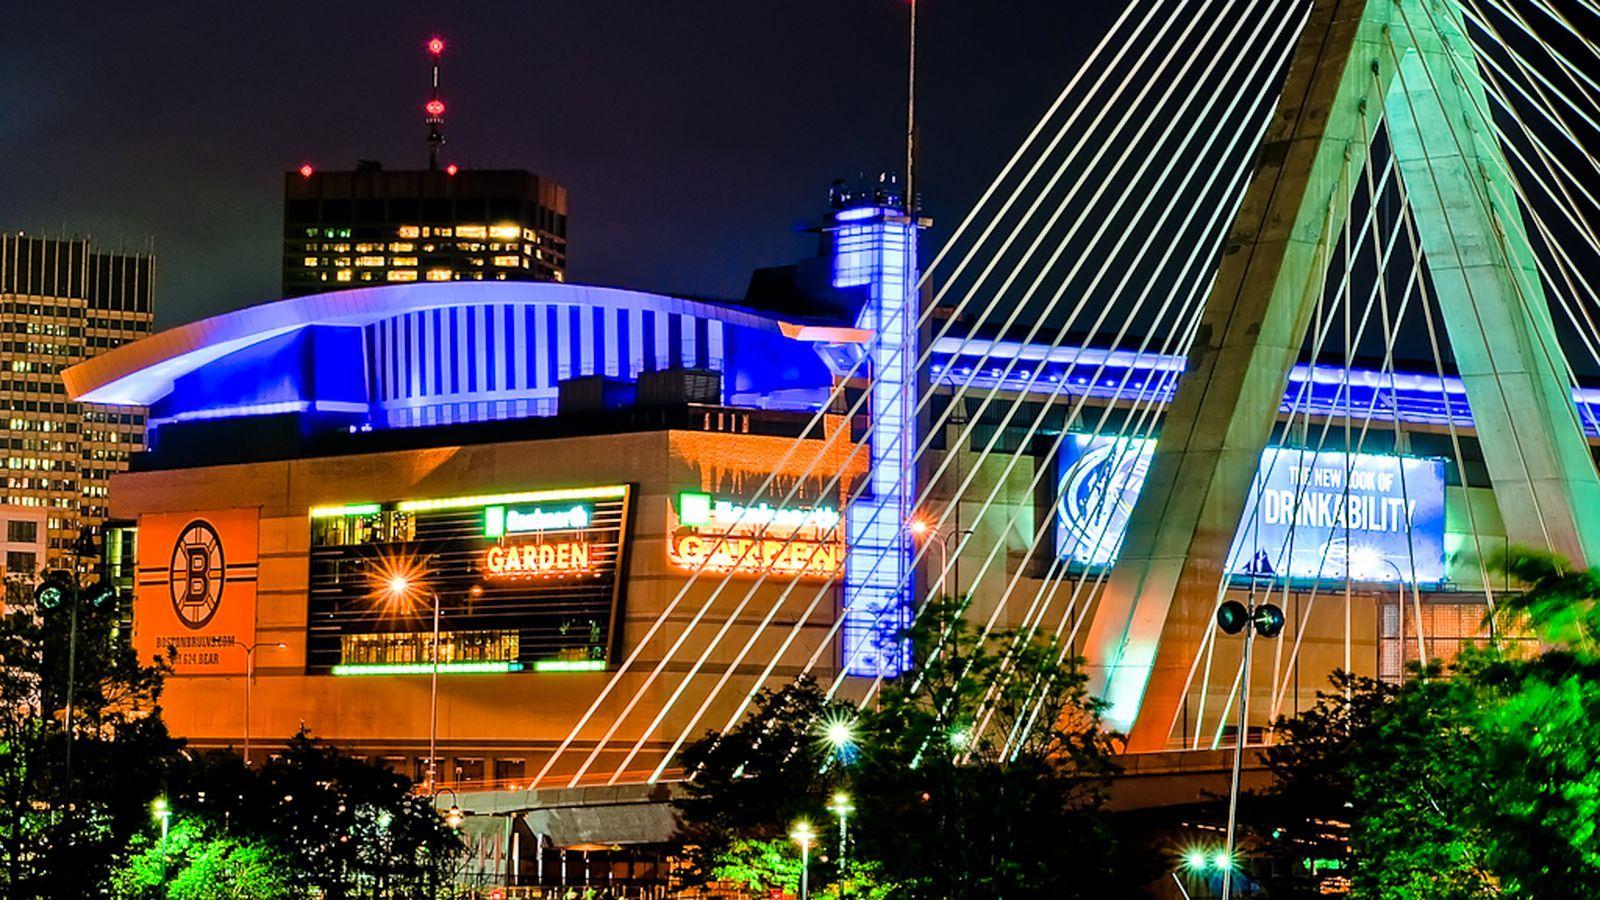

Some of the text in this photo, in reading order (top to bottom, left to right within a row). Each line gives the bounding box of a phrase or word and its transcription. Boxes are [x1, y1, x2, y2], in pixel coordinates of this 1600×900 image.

[1289, 466, 1312, 485] THE
[1315, 468, 1340, 488] NEW
[1378, 472, 1394, 491] OF
[1264, 489, 1415, 533] DRINKABILITY
[487, 542, 588, 572] GARDEN
[679, 535, 836, 572] GARDEN
[185, 544, 209, 606] B
